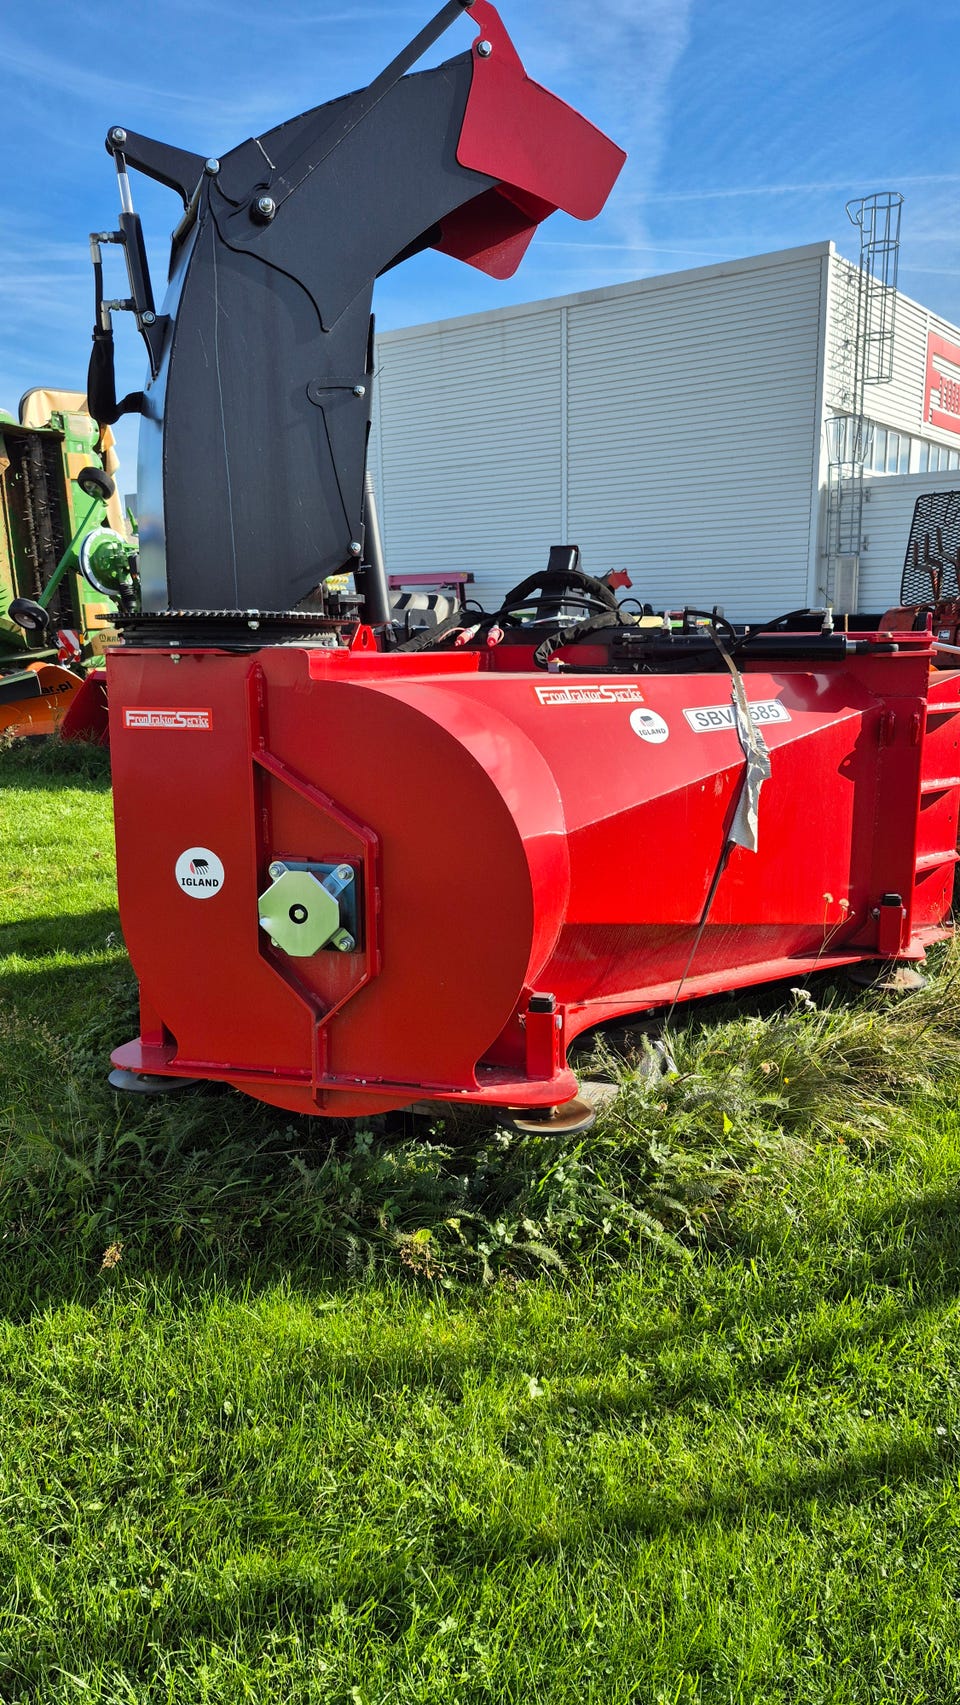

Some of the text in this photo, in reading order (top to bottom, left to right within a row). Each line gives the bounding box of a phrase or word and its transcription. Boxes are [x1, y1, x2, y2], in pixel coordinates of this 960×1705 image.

[695, 709, 732, 727] SBV
[638, 728, 666, 736] IGLAND
[182, 877, 219, 888] IGLAND
